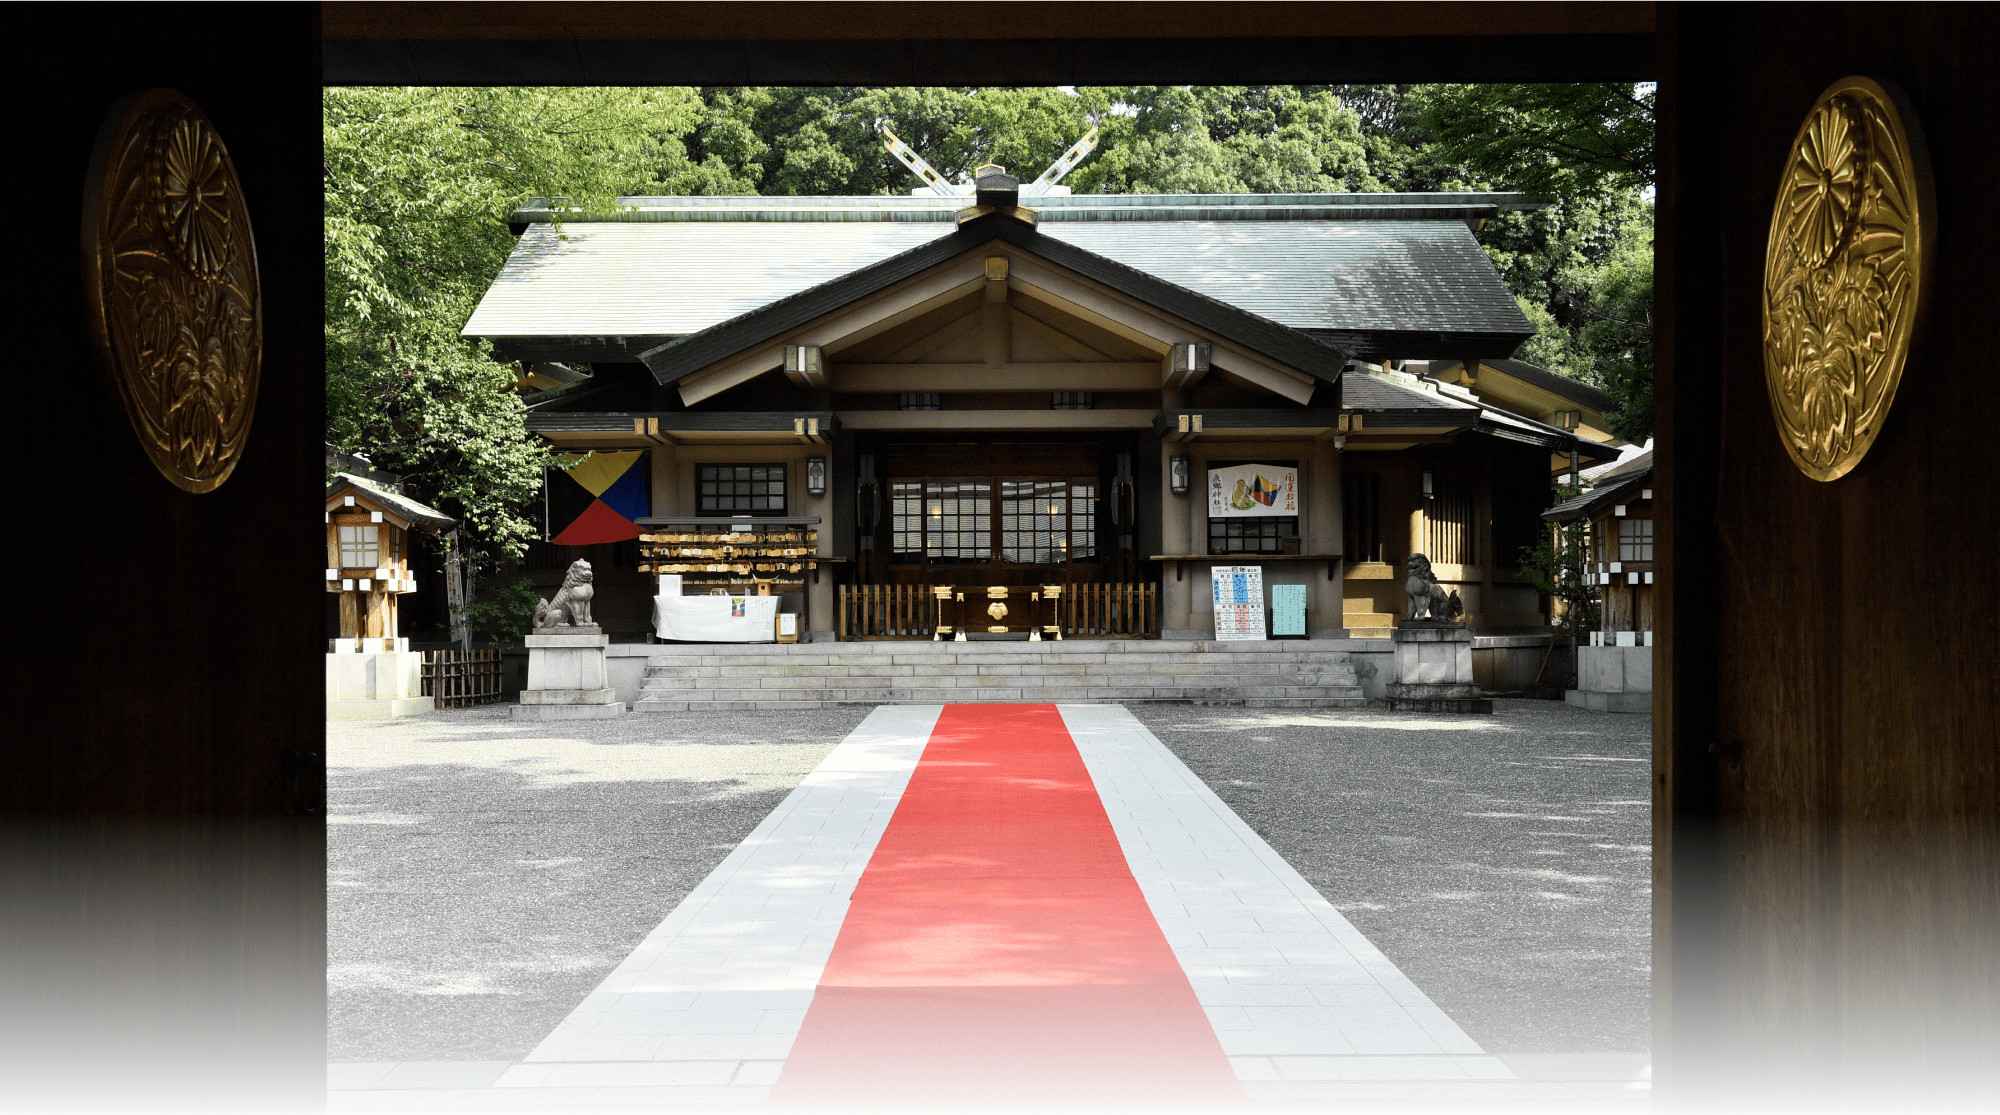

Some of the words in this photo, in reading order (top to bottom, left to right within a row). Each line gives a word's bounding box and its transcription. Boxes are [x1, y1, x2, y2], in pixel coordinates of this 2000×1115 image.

[1212, 474, 1222, 506] 東郷神社
[1285, 473, 1296, 511] 開運招福
